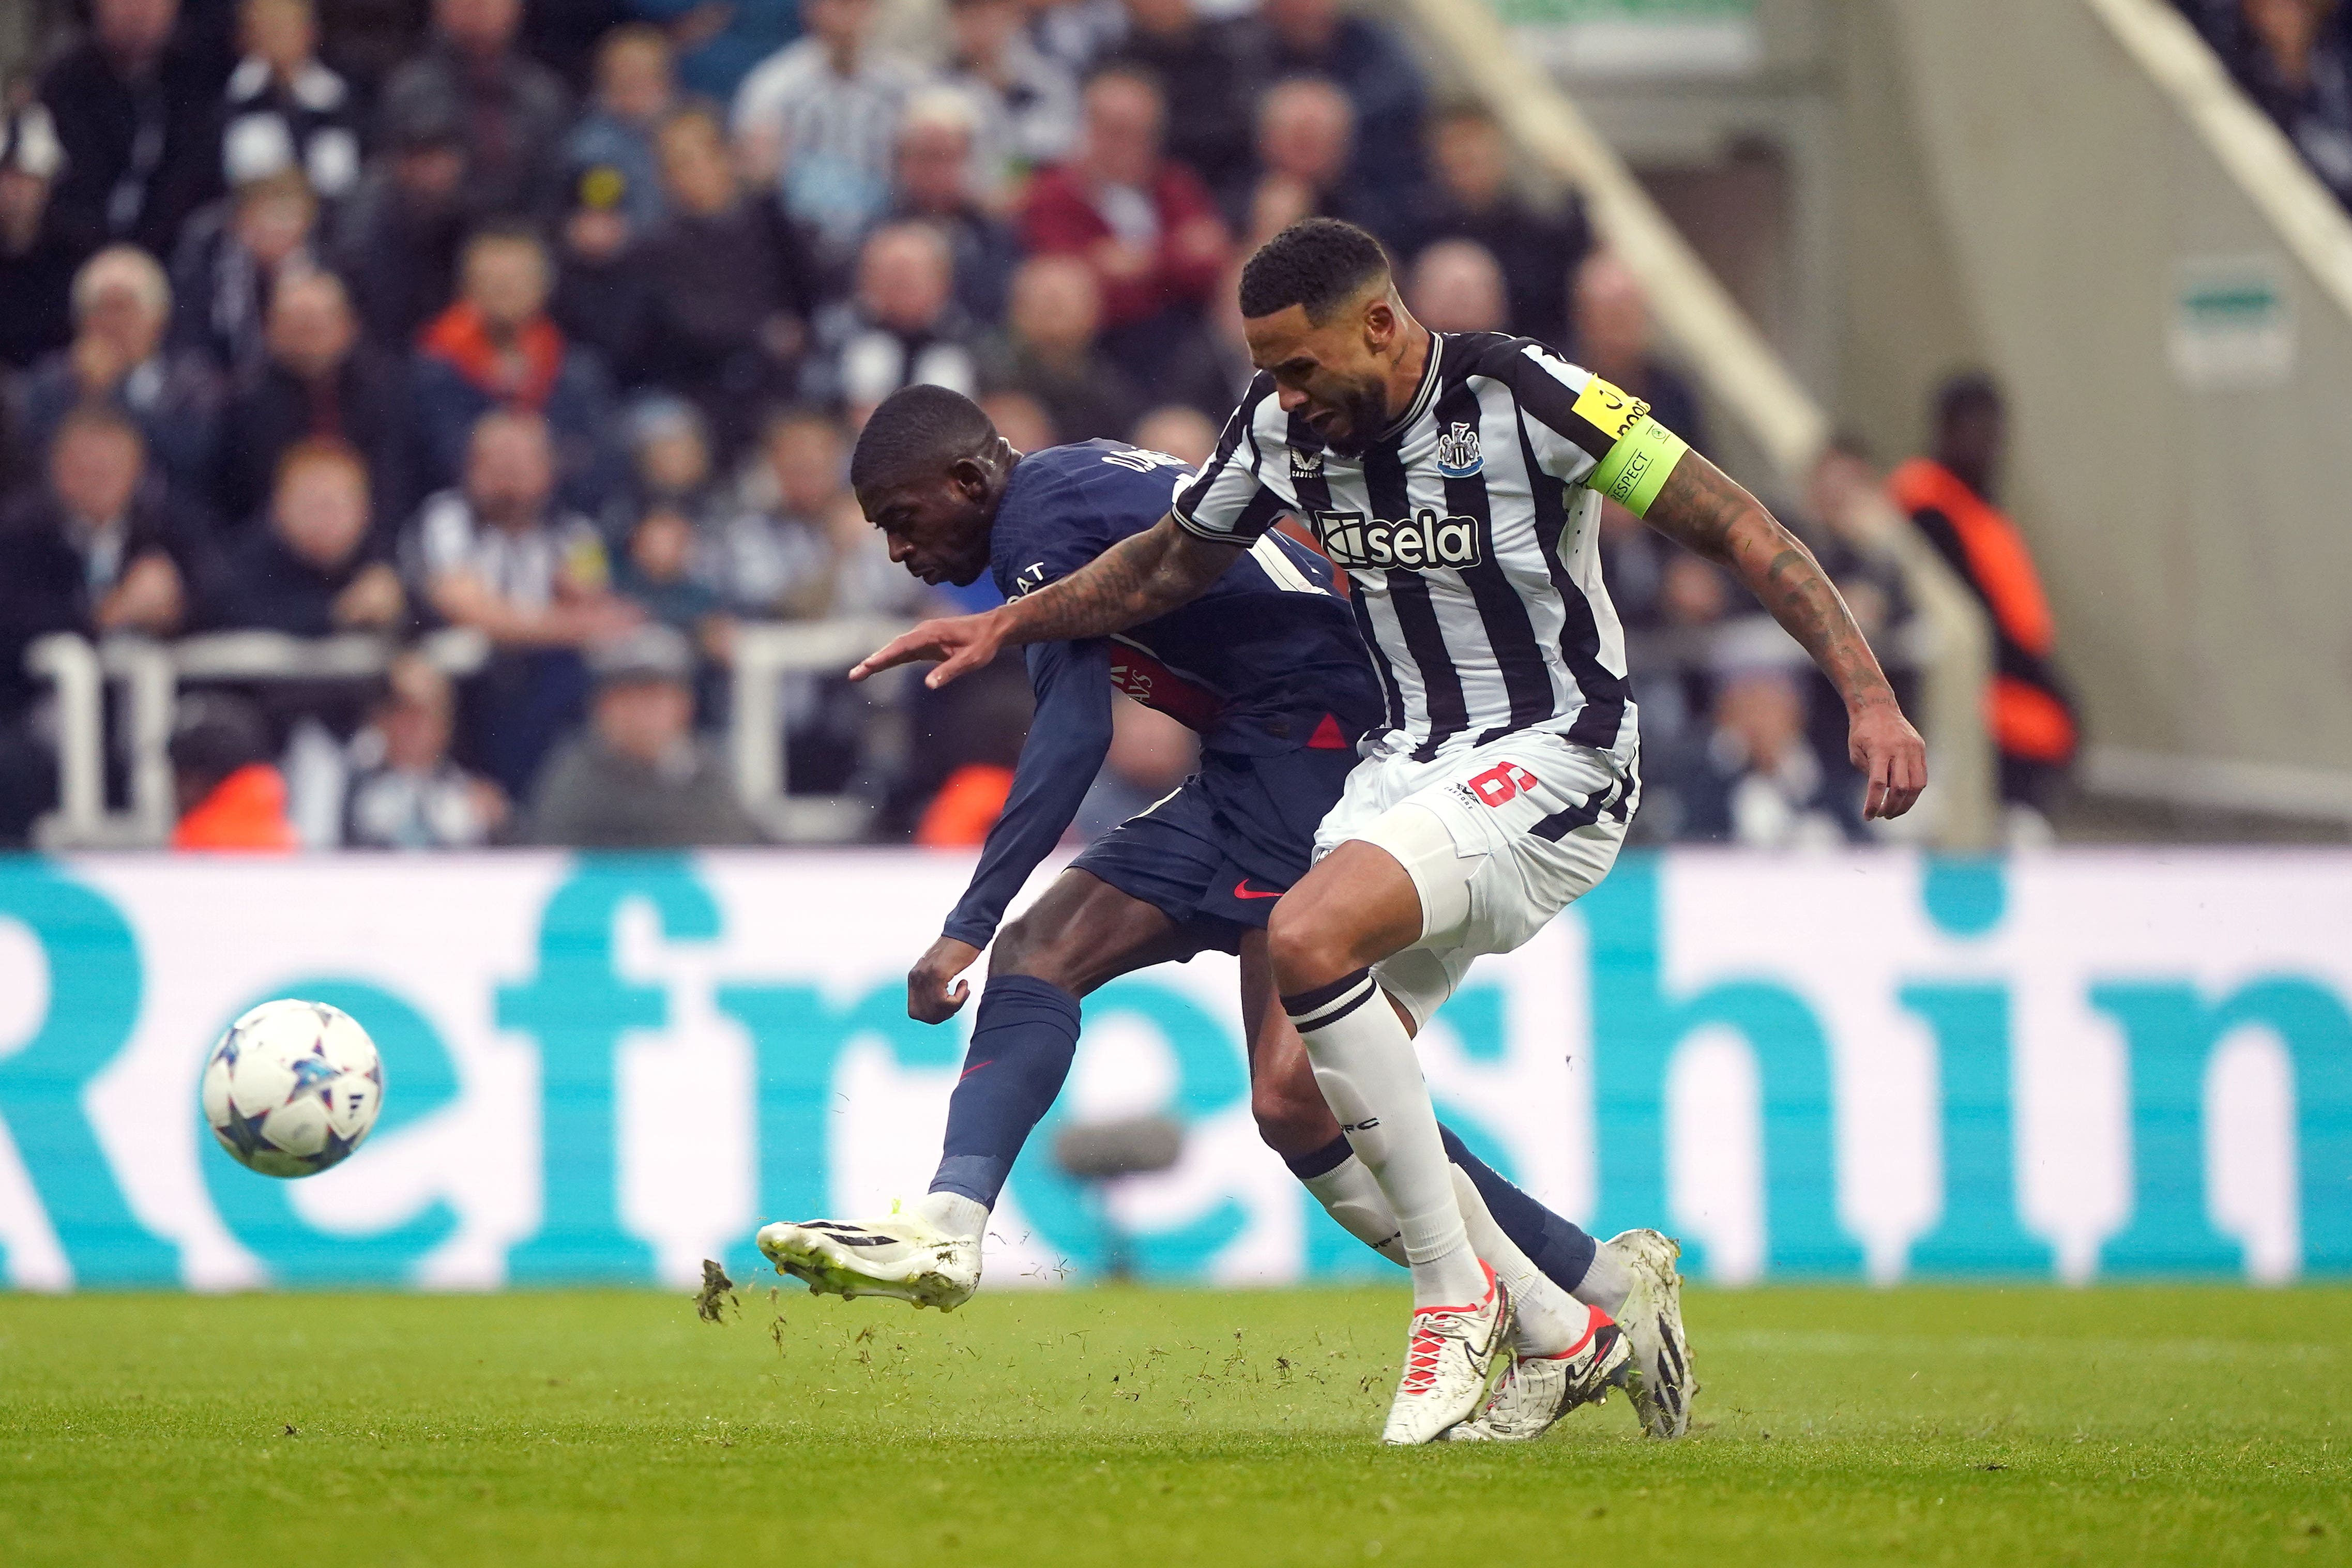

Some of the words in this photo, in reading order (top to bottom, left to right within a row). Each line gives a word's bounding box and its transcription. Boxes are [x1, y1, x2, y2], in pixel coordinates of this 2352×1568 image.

[1610, 451, 1648, 503] RESPECT
[1367, 515, 1473, 565] sela
[1467, 761, 1538, 808] 6
